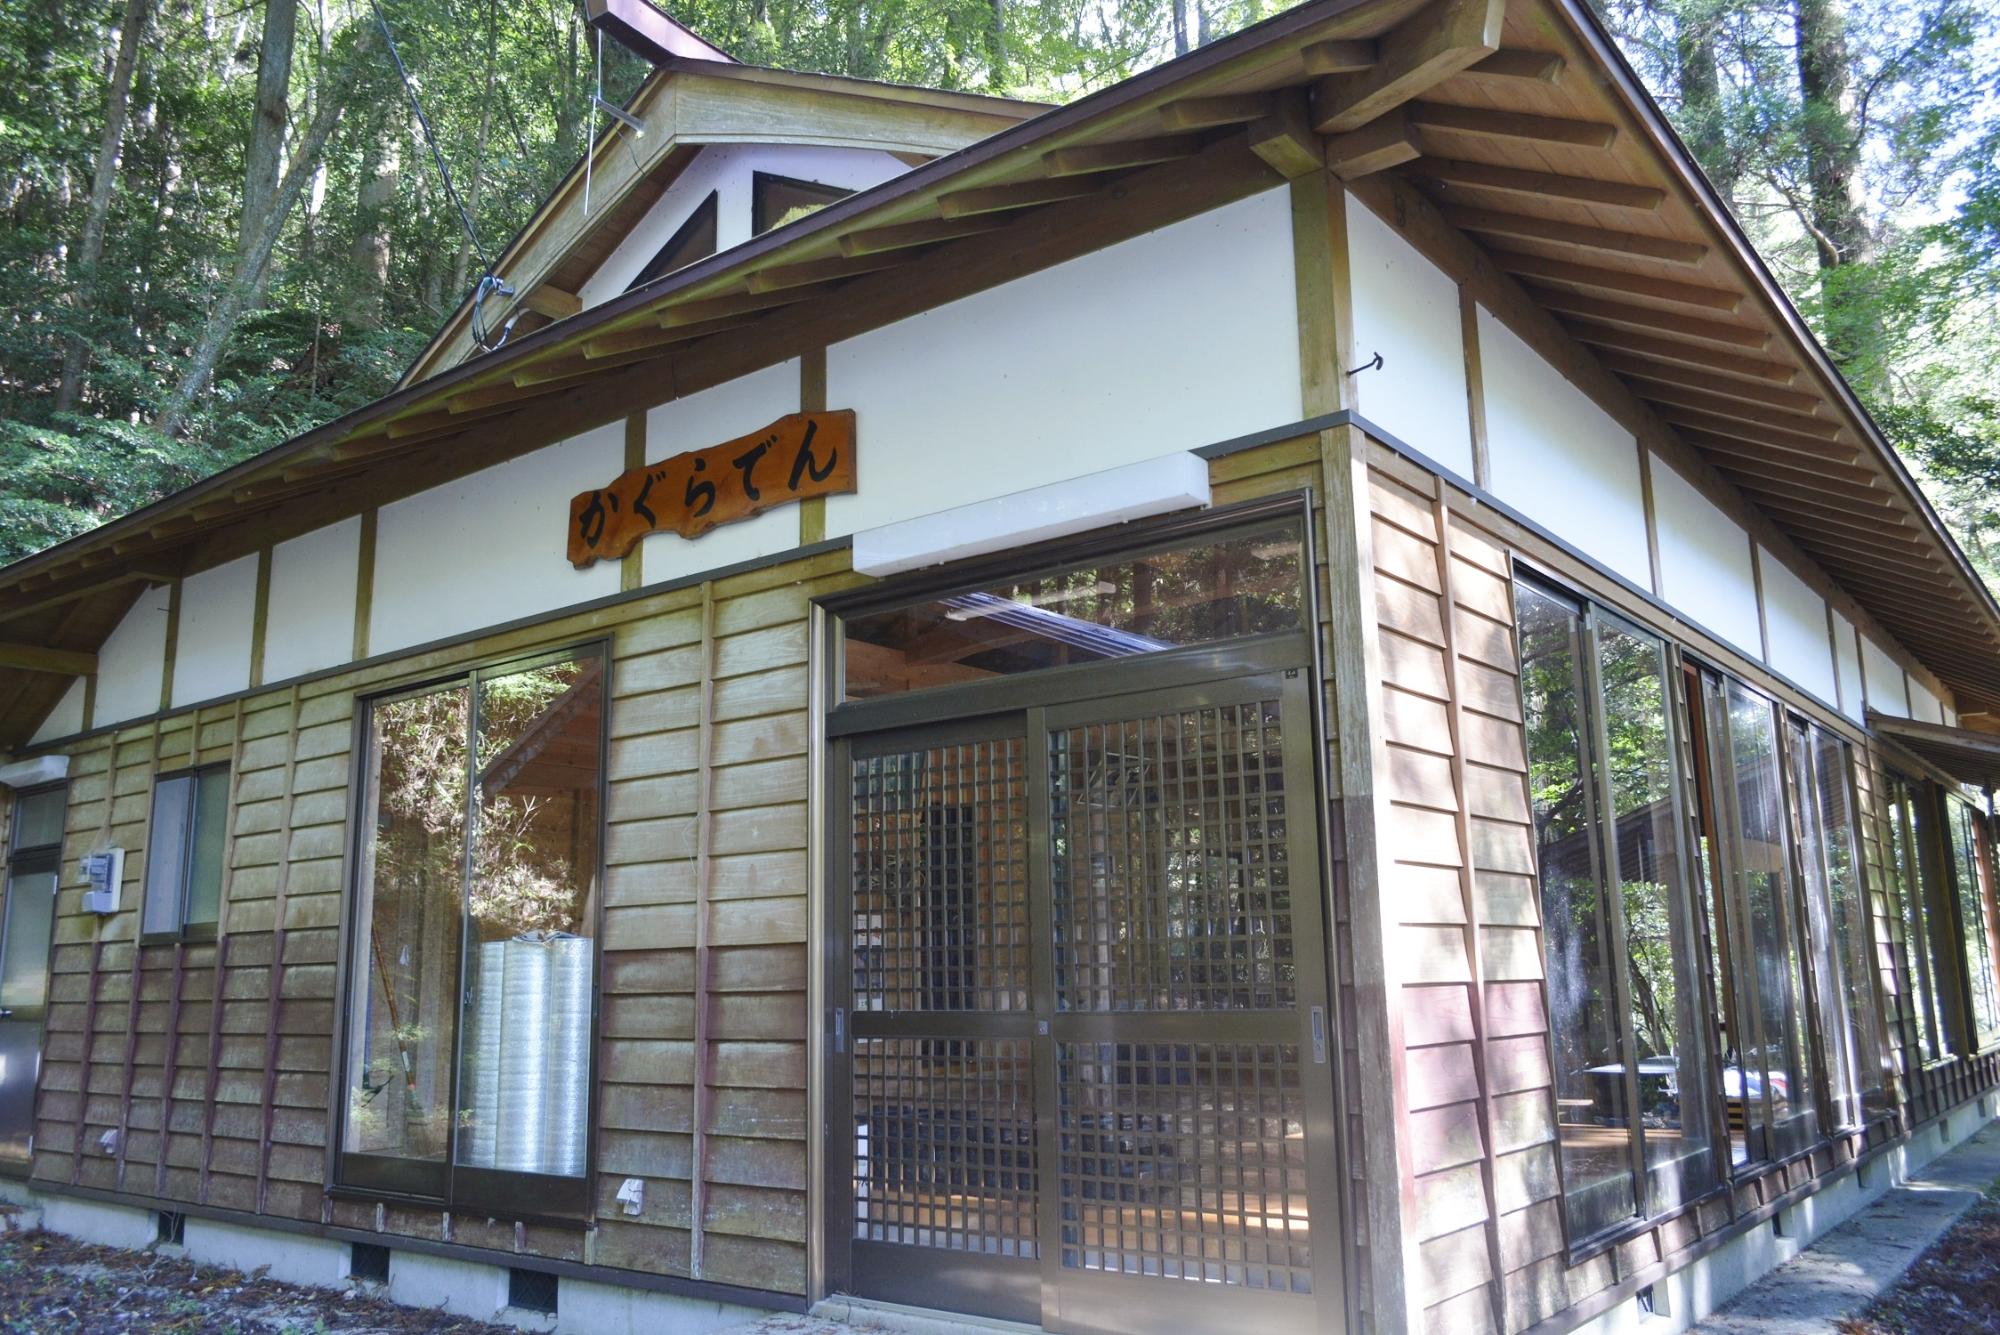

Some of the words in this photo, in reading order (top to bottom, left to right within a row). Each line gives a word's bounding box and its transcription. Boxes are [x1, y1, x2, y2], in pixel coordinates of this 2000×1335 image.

[579, 420, 836, 548] かぐらでん
